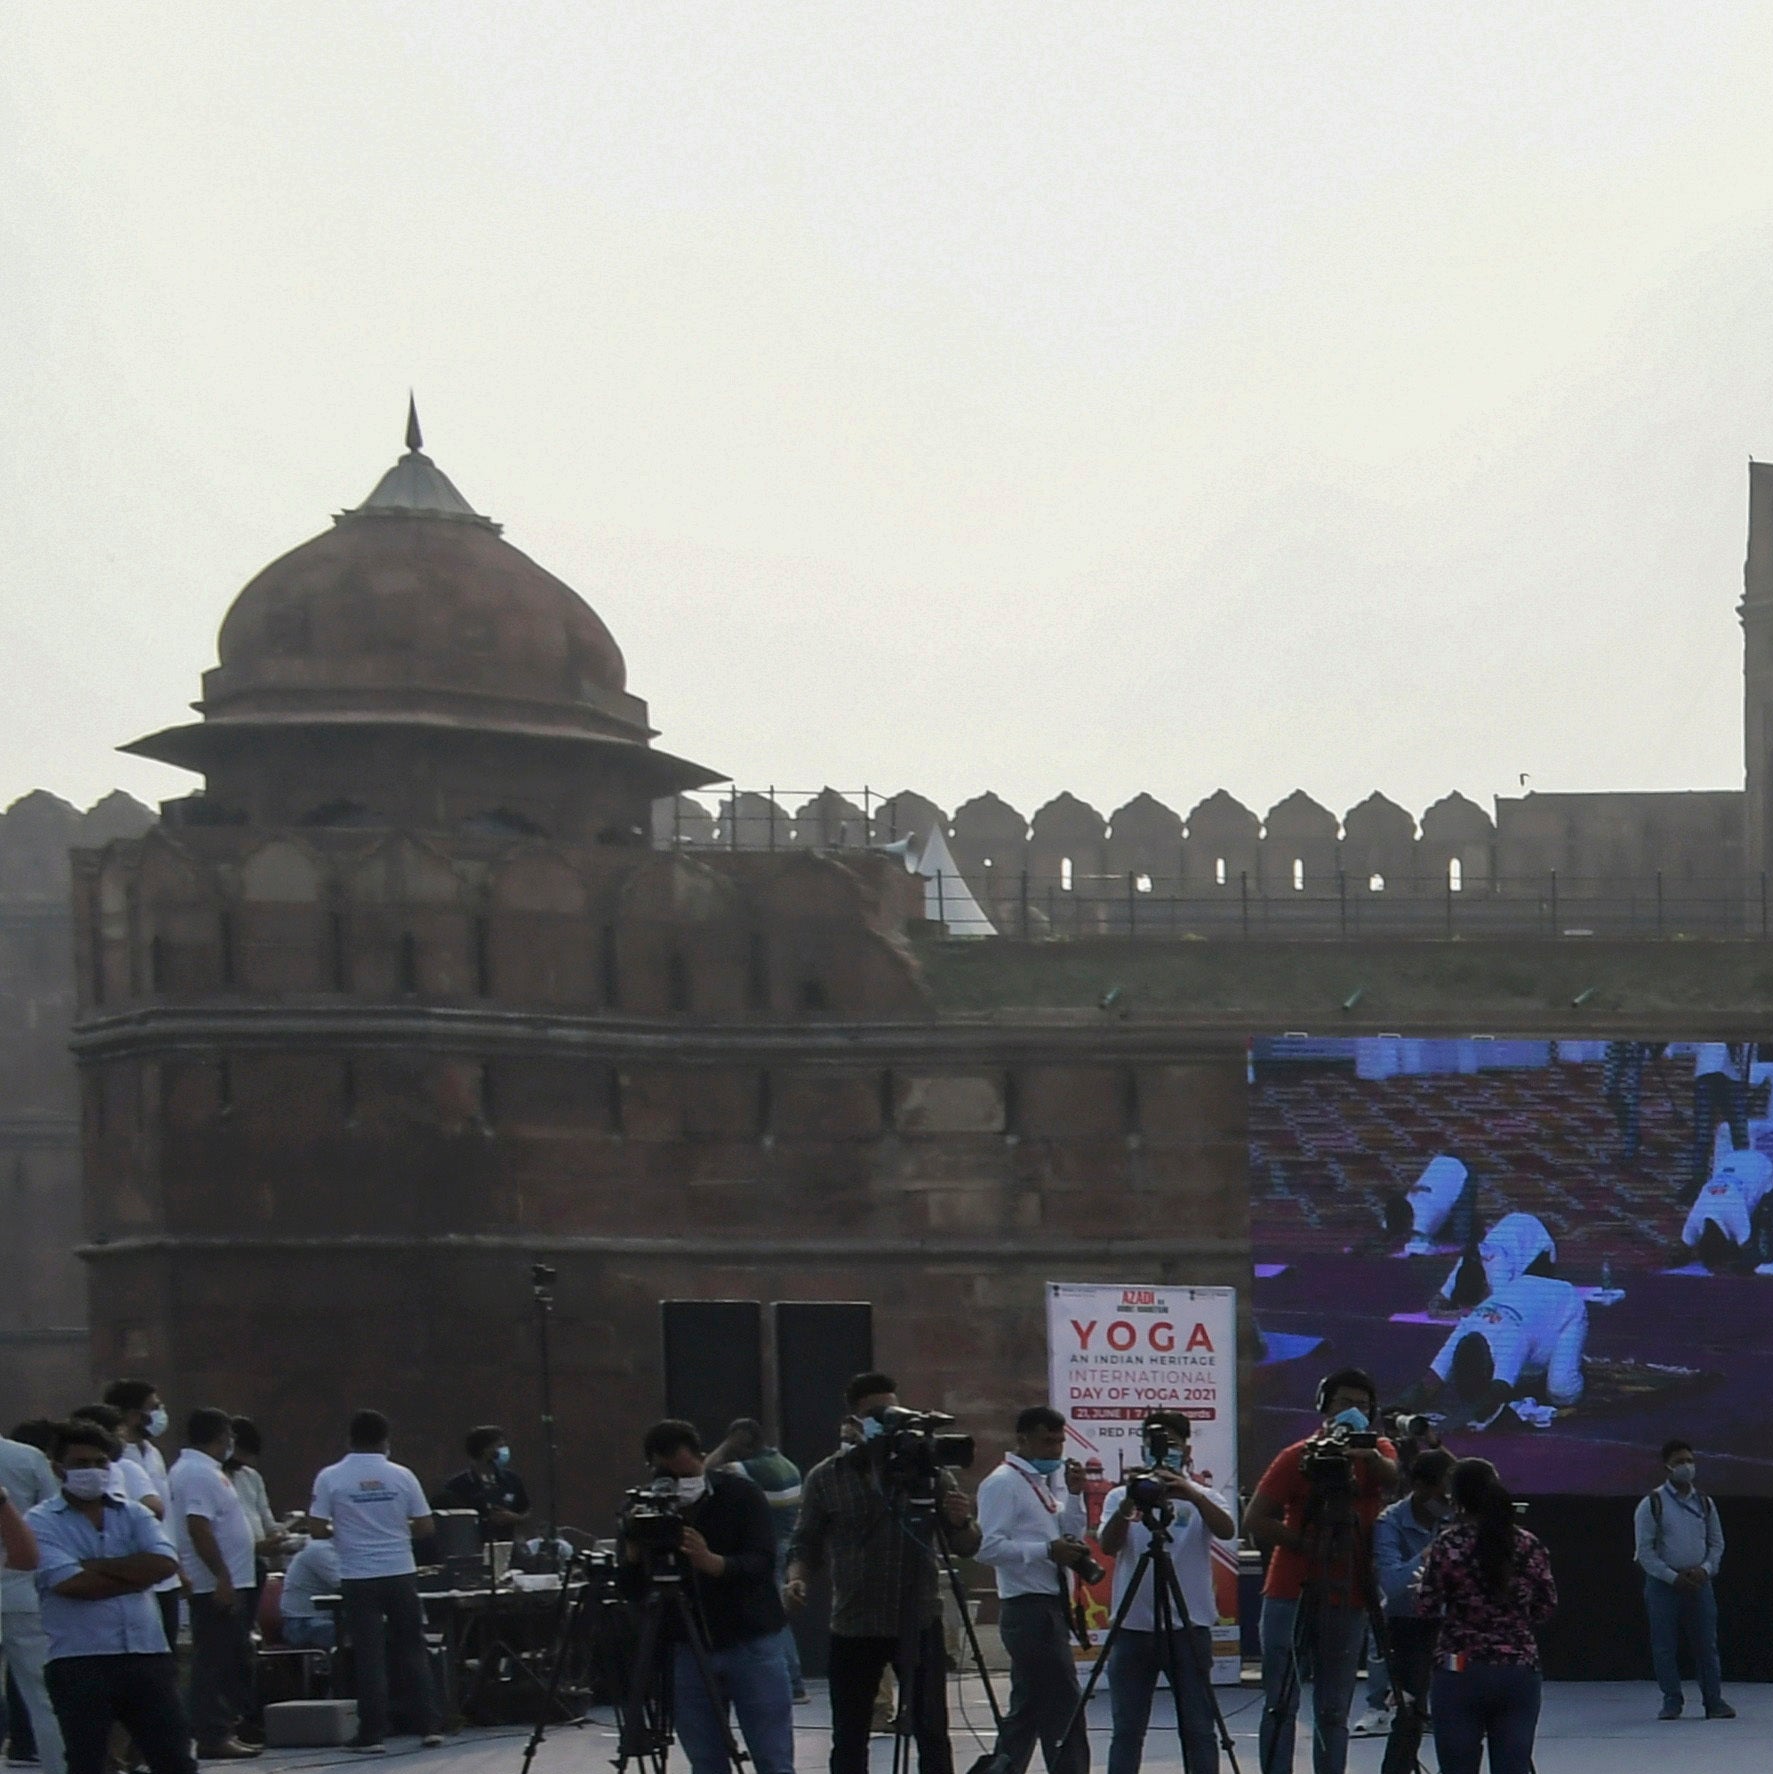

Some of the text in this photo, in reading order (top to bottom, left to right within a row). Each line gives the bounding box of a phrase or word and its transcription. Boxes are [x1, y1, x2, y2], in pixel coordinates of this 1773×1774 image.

[1070, 1320, 1214, 1352] YOGA
[1070, 1355, 1216, 1366] AN INDIAN HERITAGE
[1069, 1369, 1216, 1385] INTERNATIONAL
[1070, 1387, 1216, 1401] DAY OF YOGA 2021
[1099, 1427, 1125, 1438] RED
